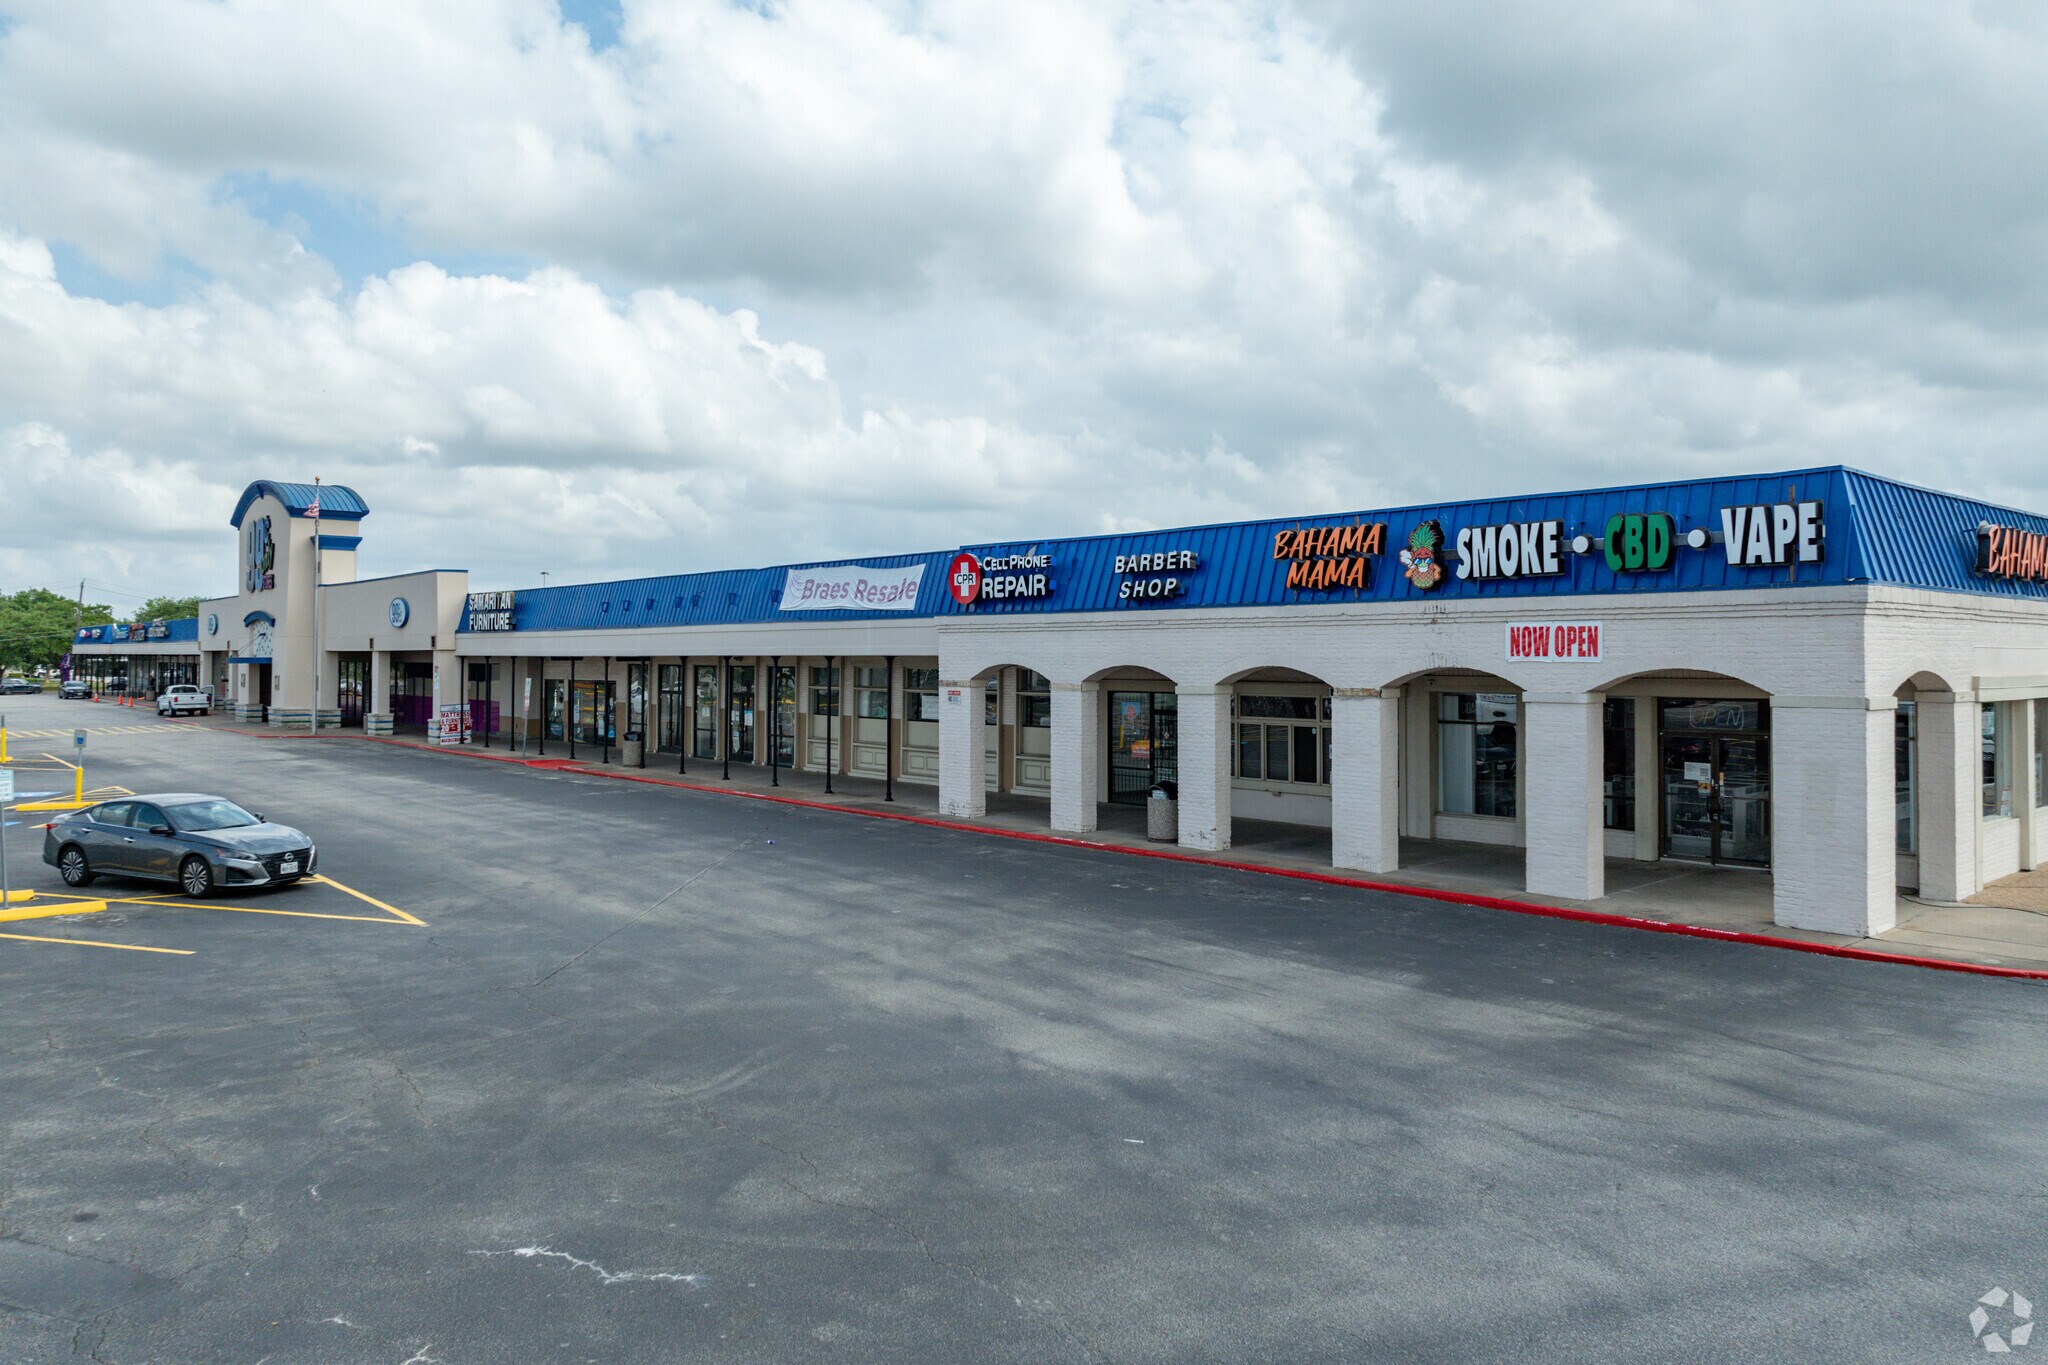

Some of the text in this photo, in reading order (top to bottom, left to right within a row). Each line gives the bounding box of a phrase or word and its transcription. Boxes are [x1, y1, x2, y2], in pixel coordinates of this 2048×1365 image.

[1273, 523, 1381, 560] BAHAMA
[1456, 502, 1818, 579] SMOKE CBD VAPE
[983, 555, 1047, 571] CELL PHONE
[1115, 550, 1192, 573] BARBER
[1286, 557, 1364, 589] MAMA
[801, 578, 918, 603] Braes Resale
[956, 574, 974, 584] CPR
[981, 574, 1046, 599] REPAIR
[1119, 578, 1177, 599] SHOP
[469, 592, 511, 611] SAMARITAN
[470, 612, 510, 631] FURNITURE
[1510, 626, 1599, 657] NOW OPEN
[1692, 708, 1742, 726] OPEN
